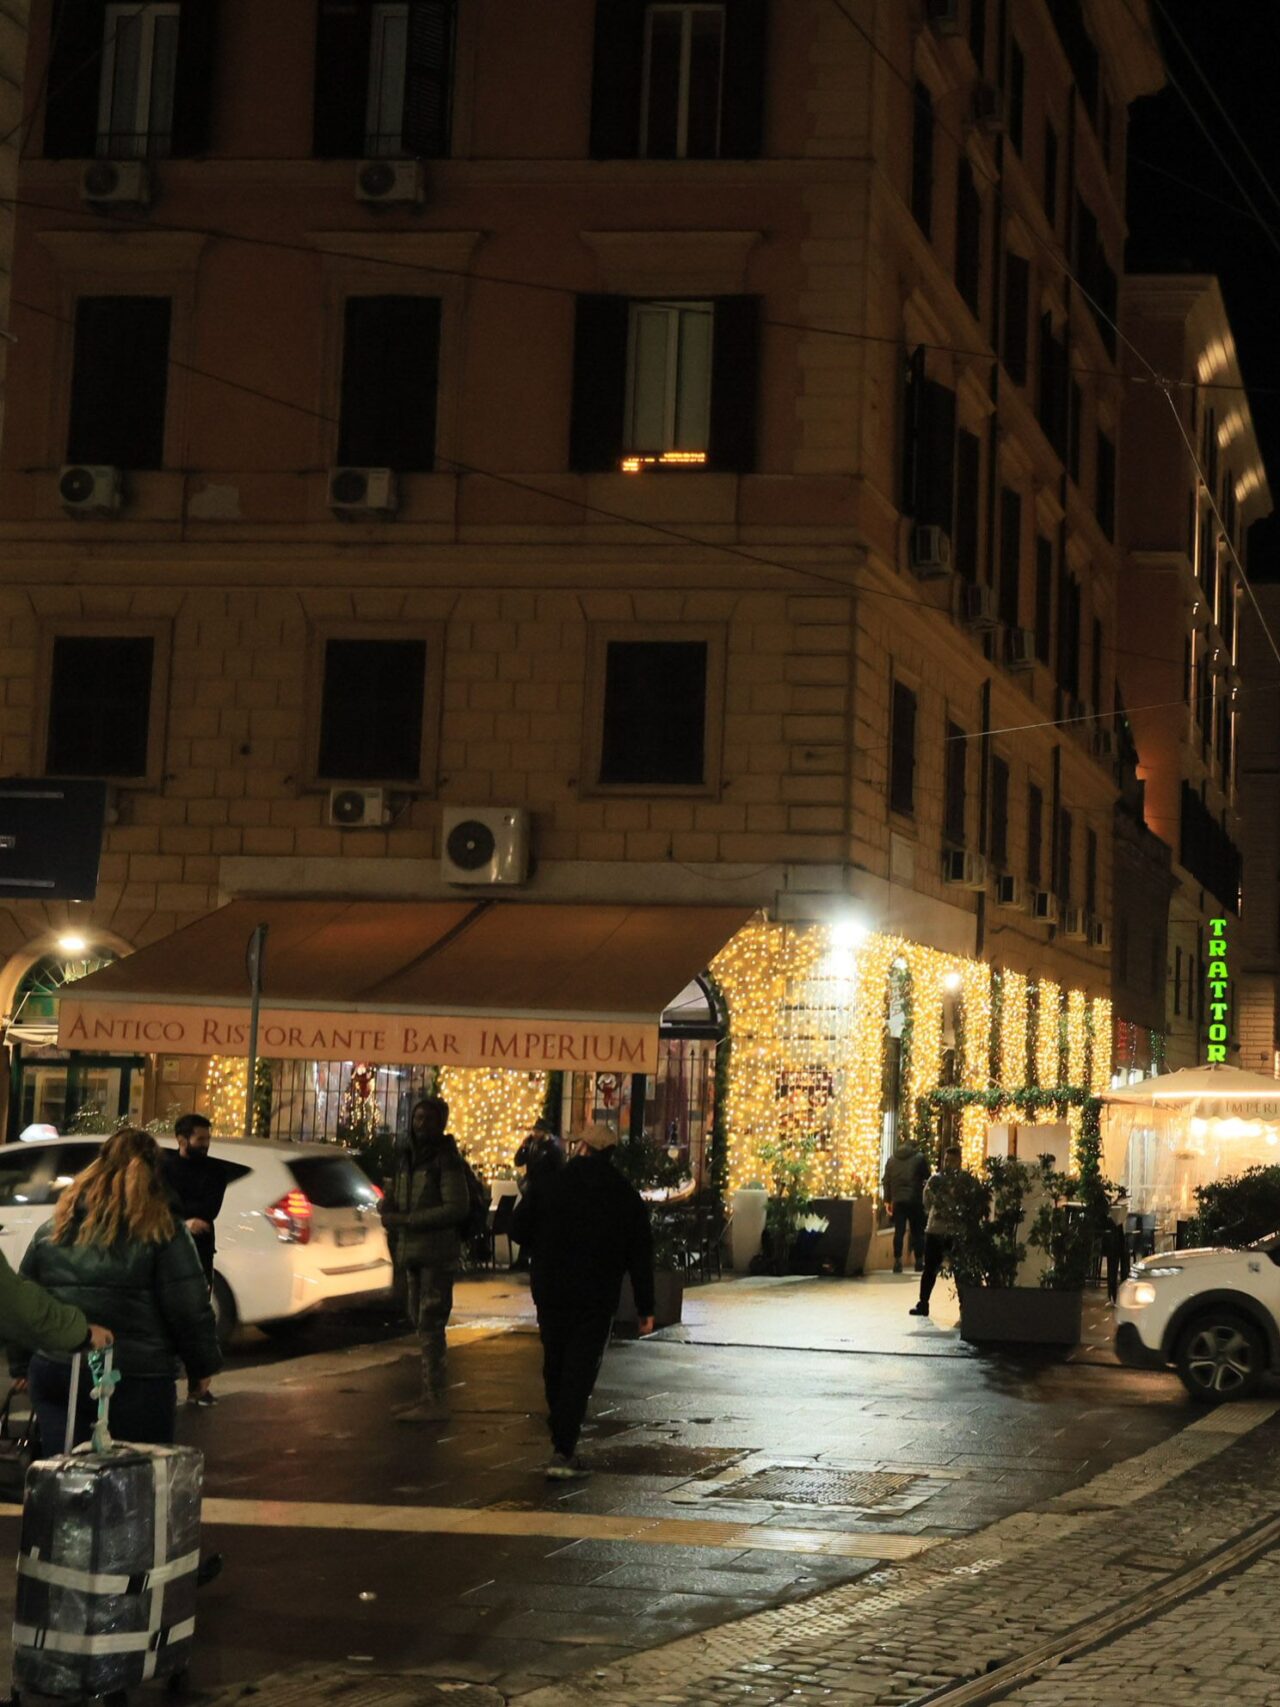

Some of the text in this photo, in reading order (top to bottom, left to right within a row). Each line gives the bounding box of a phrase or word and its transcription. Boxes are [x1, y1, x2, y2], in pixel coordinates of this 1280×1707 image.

[1207, 919, 1229, 1062] TRATTOR
[202, 1018, 386, 1051] RISORANTE
[479, 1030, 647, 1063] IMPERIUM
